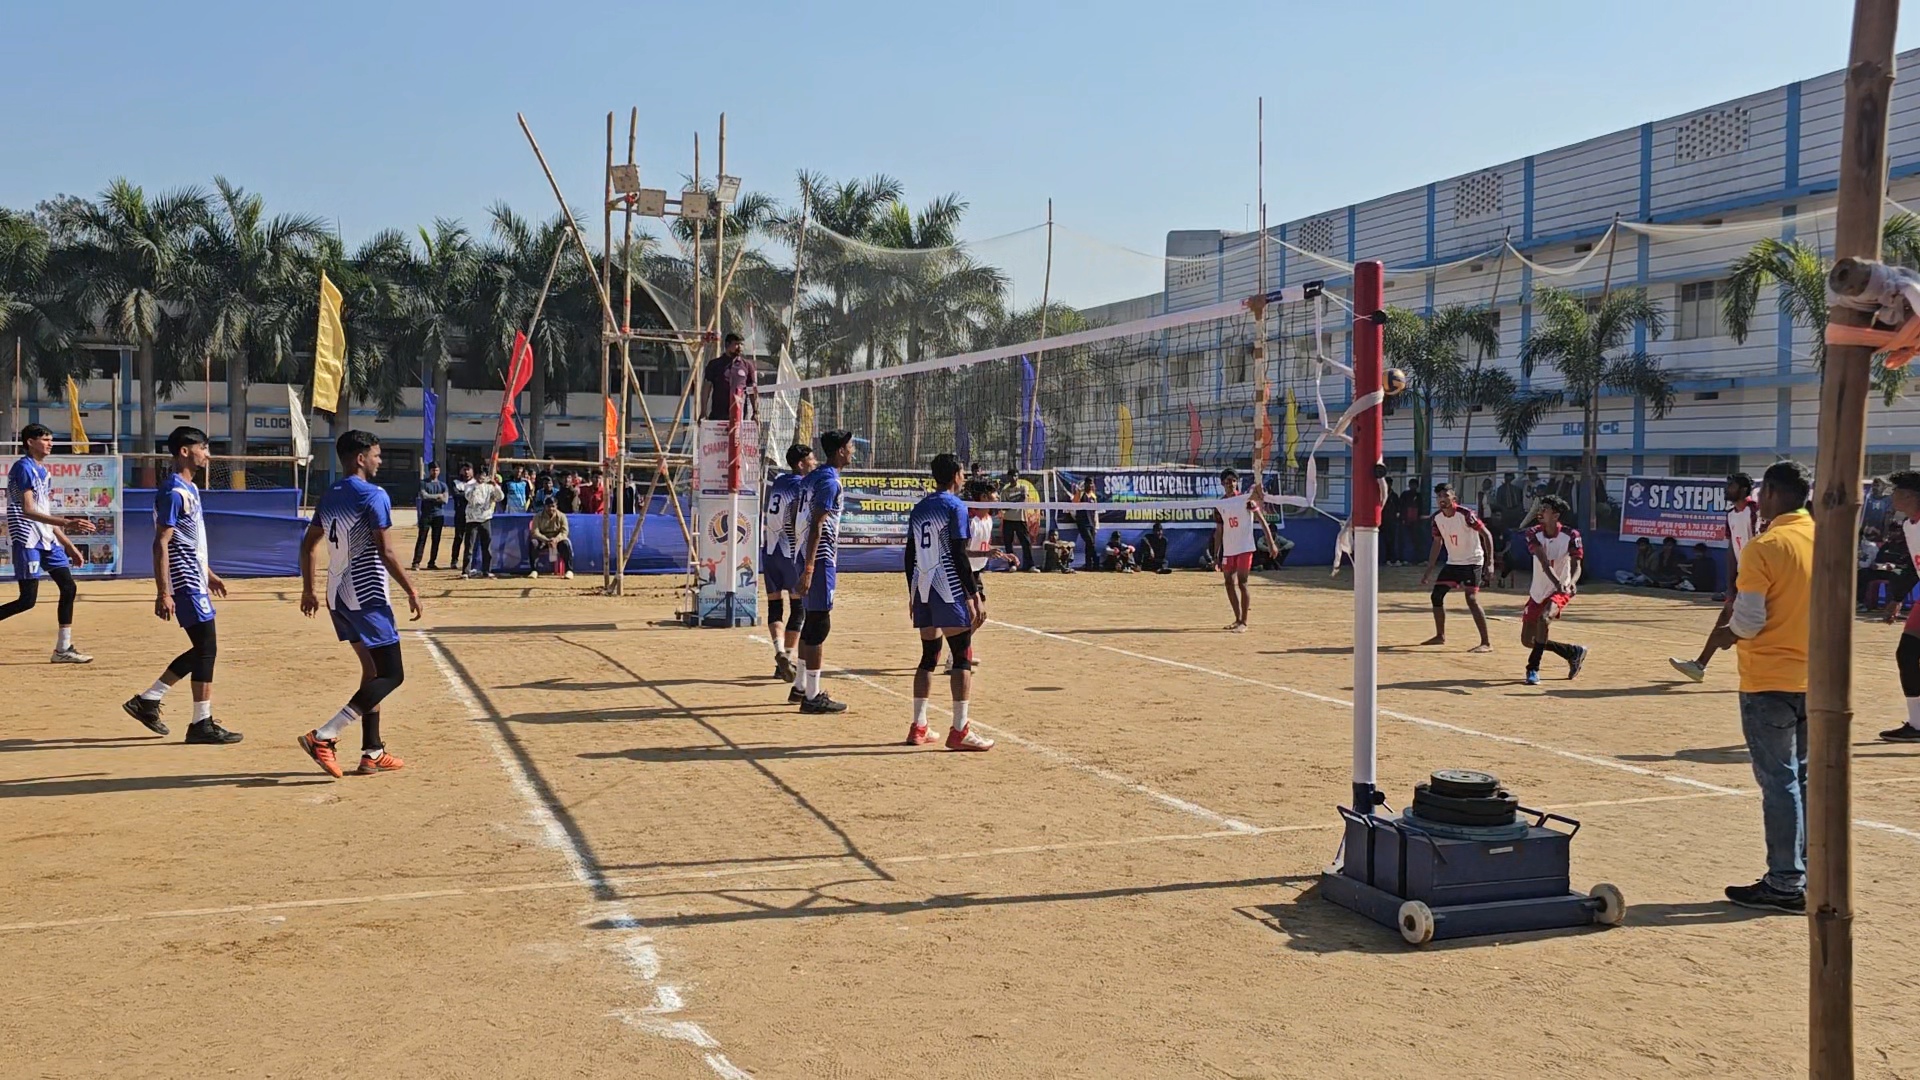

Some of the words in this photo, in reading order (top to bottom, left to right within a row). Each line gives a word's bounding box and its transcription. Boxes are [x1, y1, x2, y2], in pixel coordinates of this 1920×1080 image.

[1563, 421, 1619, 436] BLO-C
[1132, 475, 1194, 495] VOLLEYBALL
[769, 494, 782, 515] 3
[1648, 484, 1670, 509] ST.
[1125, 508, 1193, 520] ADMISSION
[328, 518, 339, 550] 4
[920, 521, 931, 549] 6
[1657, 521, 1673, 529] OPEN
[28, 561, 39, 574] 17
